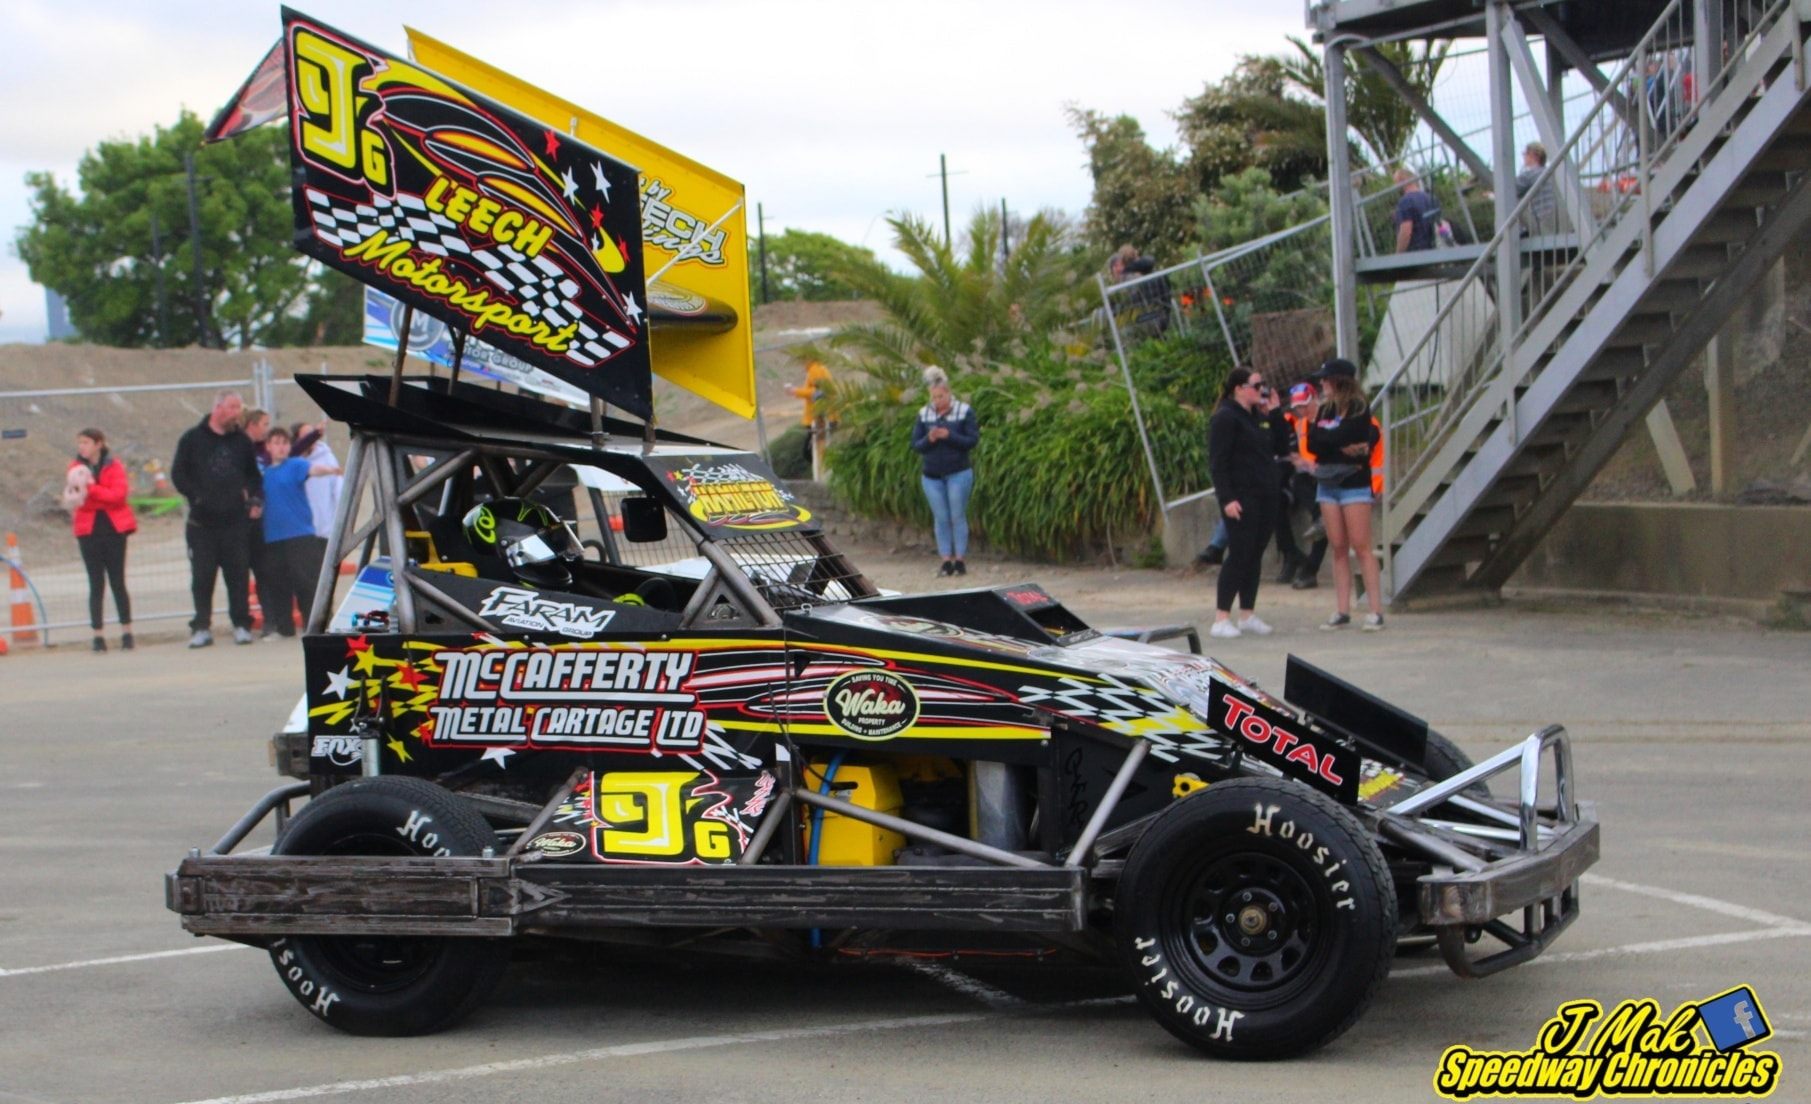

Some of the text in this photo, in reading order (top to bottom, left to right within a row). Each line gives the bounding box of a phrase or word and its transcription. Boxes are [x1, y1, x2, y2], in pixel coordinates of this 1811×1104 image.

[425, 177, 553, 258] LEECH
[640, 195, 726, 251] ECH
[641, 222, 725, 264] ings
[343, 230, 579, 352] Motorsport
[490, 352, 534, 374] GROUP
[482, 587, 614, 629] FARAM
[507, 616, 592, 637] AVIATION GROUP
[872, 674, 885, 682] YOU
[885, 677, 898, 687] TIME
[835, 688, 906, 716] Waka
[858, 717, 886, 726] PROPERTY
[430, 706, 703, 746] METAL CARTAGE LTD
[841, 718, 863, 733] BUILDING
[868, 722, 902, 736] MAINTENANCE
[1223, 694, 1343, 786] TOTAL
[1246, 802, 1356, 910] Hoosier
[272, 938, 341, 1017] Hoosi
[1134, 937, 1246, 1042] Hoosier
